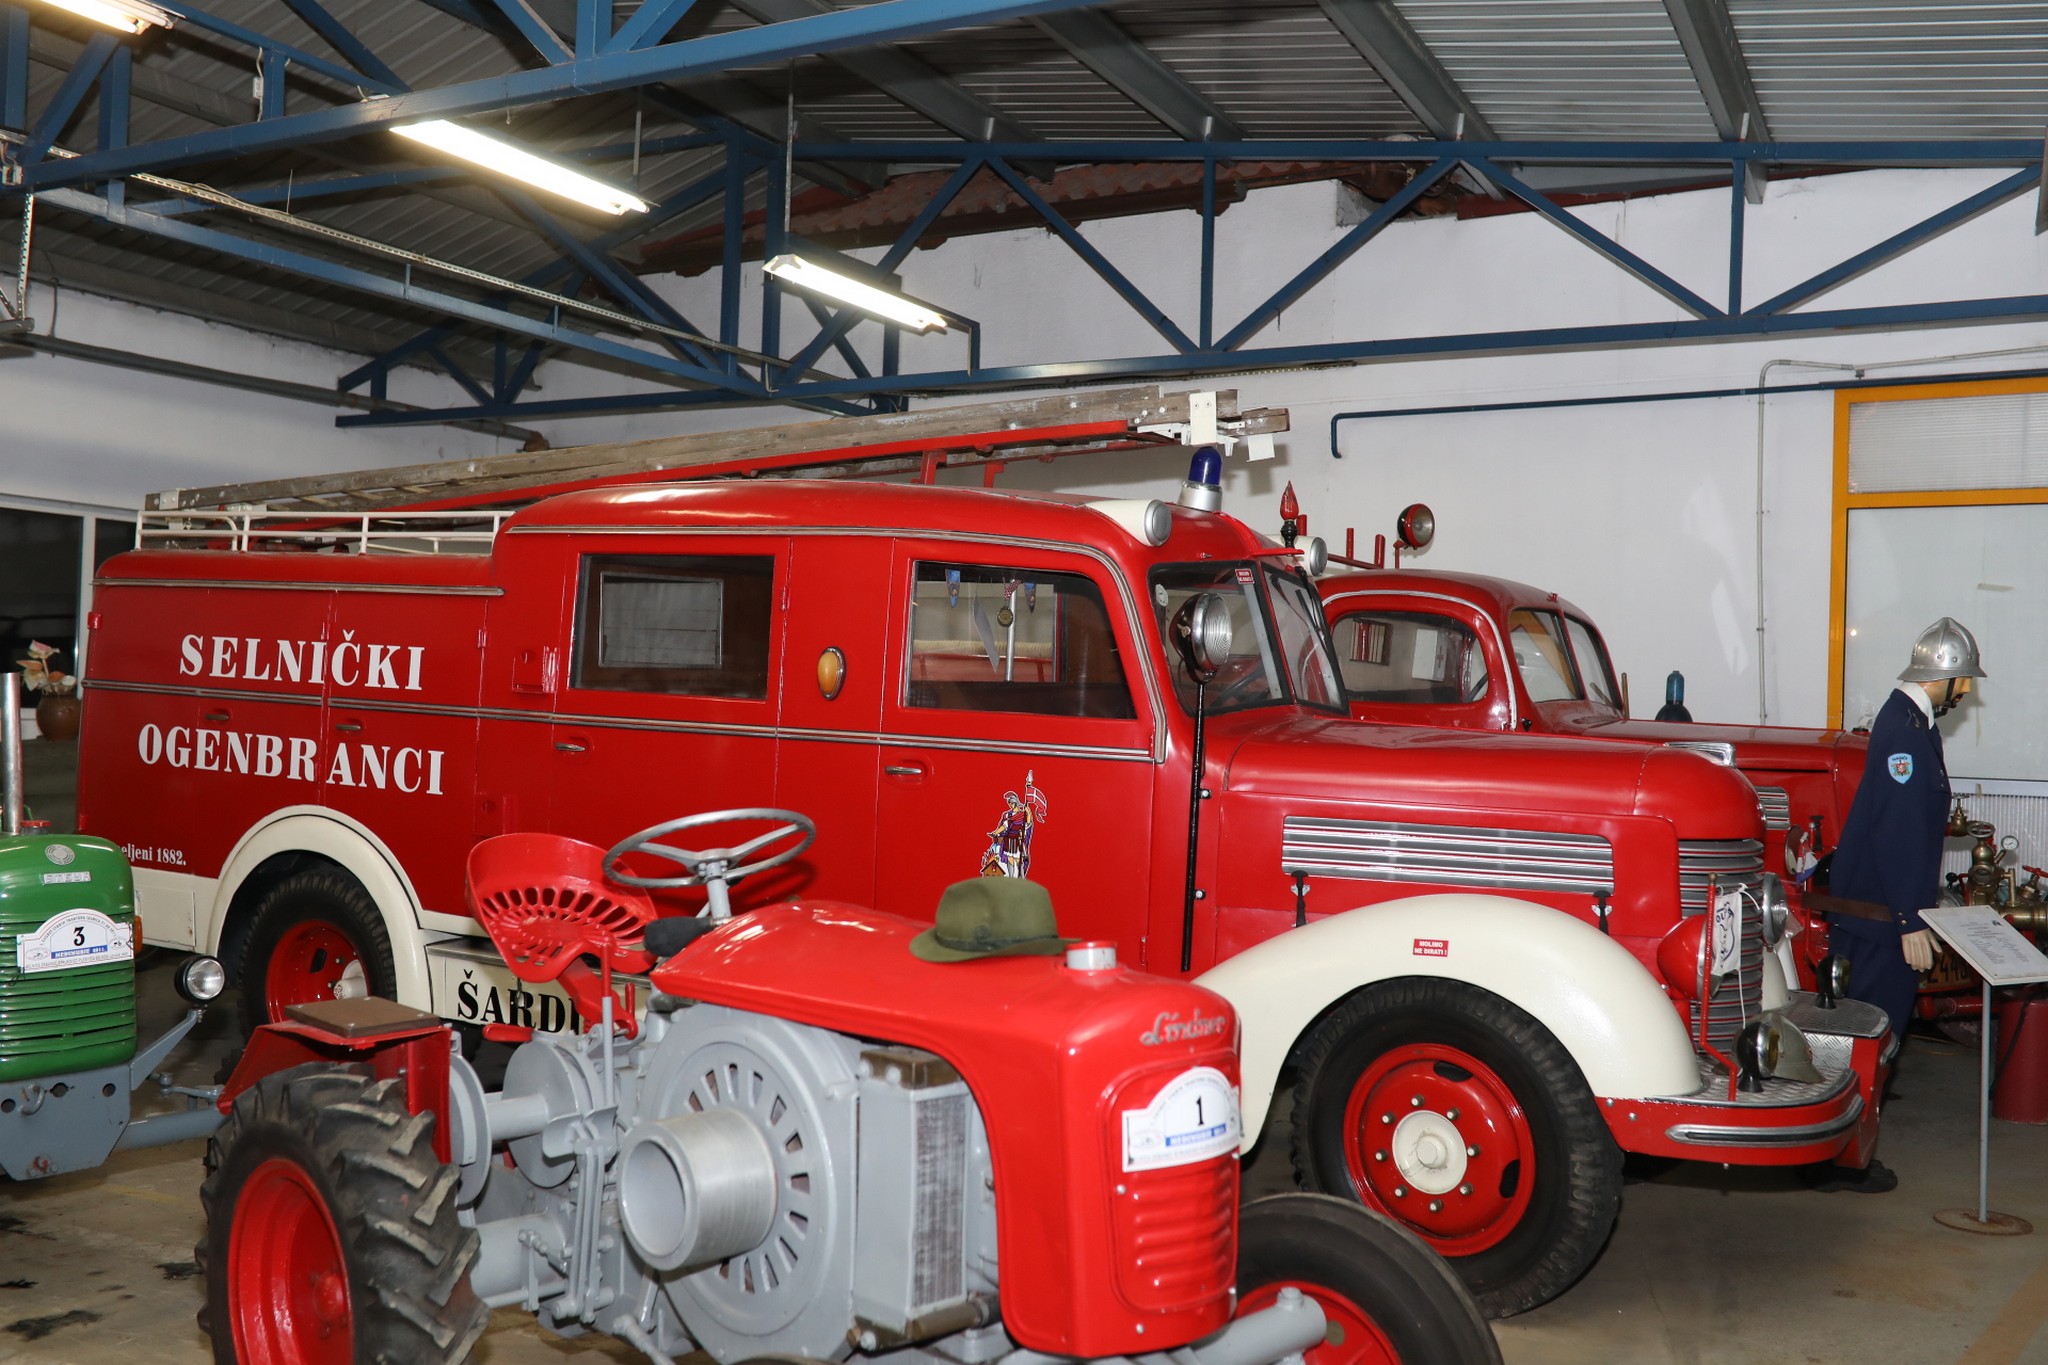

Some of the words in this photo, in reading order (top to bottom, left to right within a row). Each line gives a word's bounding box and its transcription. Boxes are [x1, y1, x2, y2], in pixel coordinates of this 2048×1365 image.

[179, 629, 425, 690] SELNIČKI
[138, 723, 445, 795] OGENBRANCI
[120, 843, 153, 862] eljeni
[156, 848, 187, 866] 1882.
[73, 926, 85, 947] 3
[1196, 1095, 1205, 1126] 1
